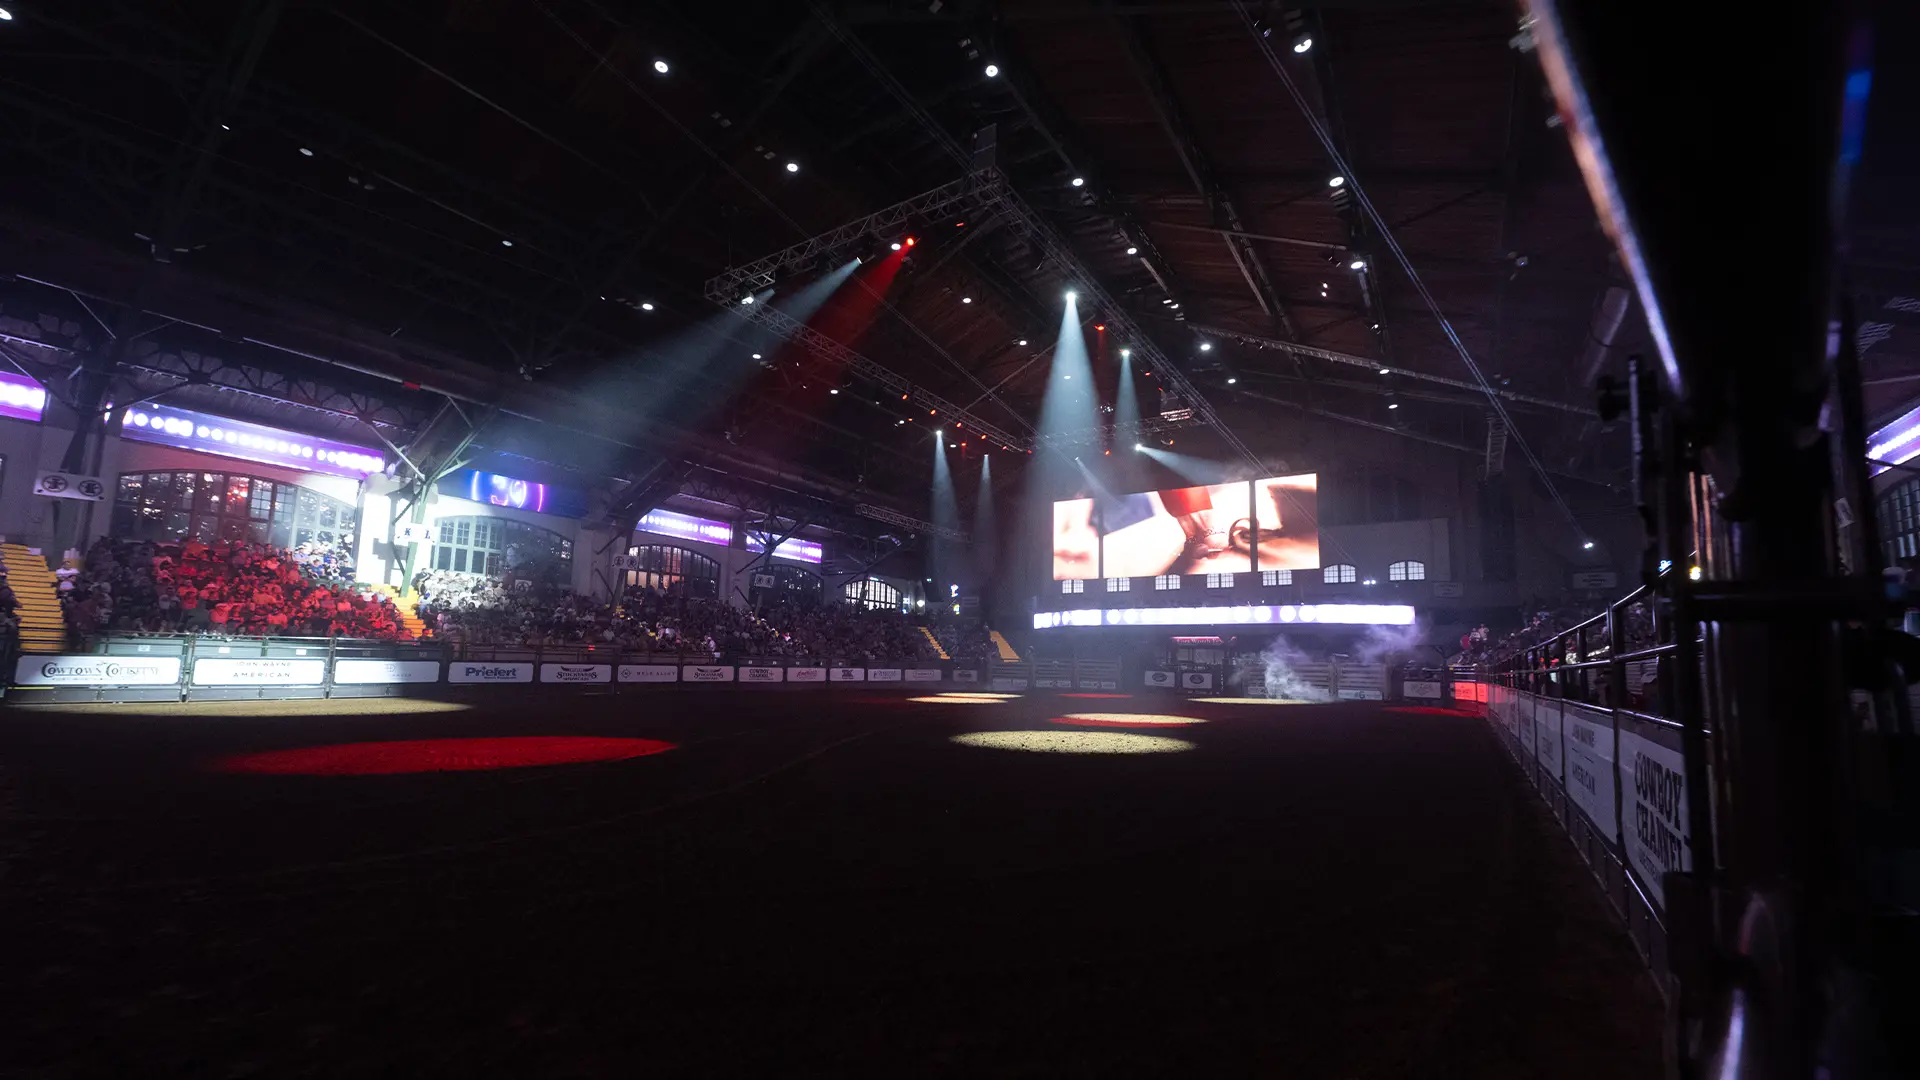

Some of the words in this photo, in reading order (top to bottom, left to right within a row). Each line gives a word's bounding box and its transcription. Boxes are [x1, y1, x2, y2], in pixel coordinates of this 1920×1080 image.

[424, 530, 431, 540] L
[41, 662, 102, 677] COWTOWN
[465, 666, 517, 677] Priefert
[1634, 751, 1683, 831] COWBOY
